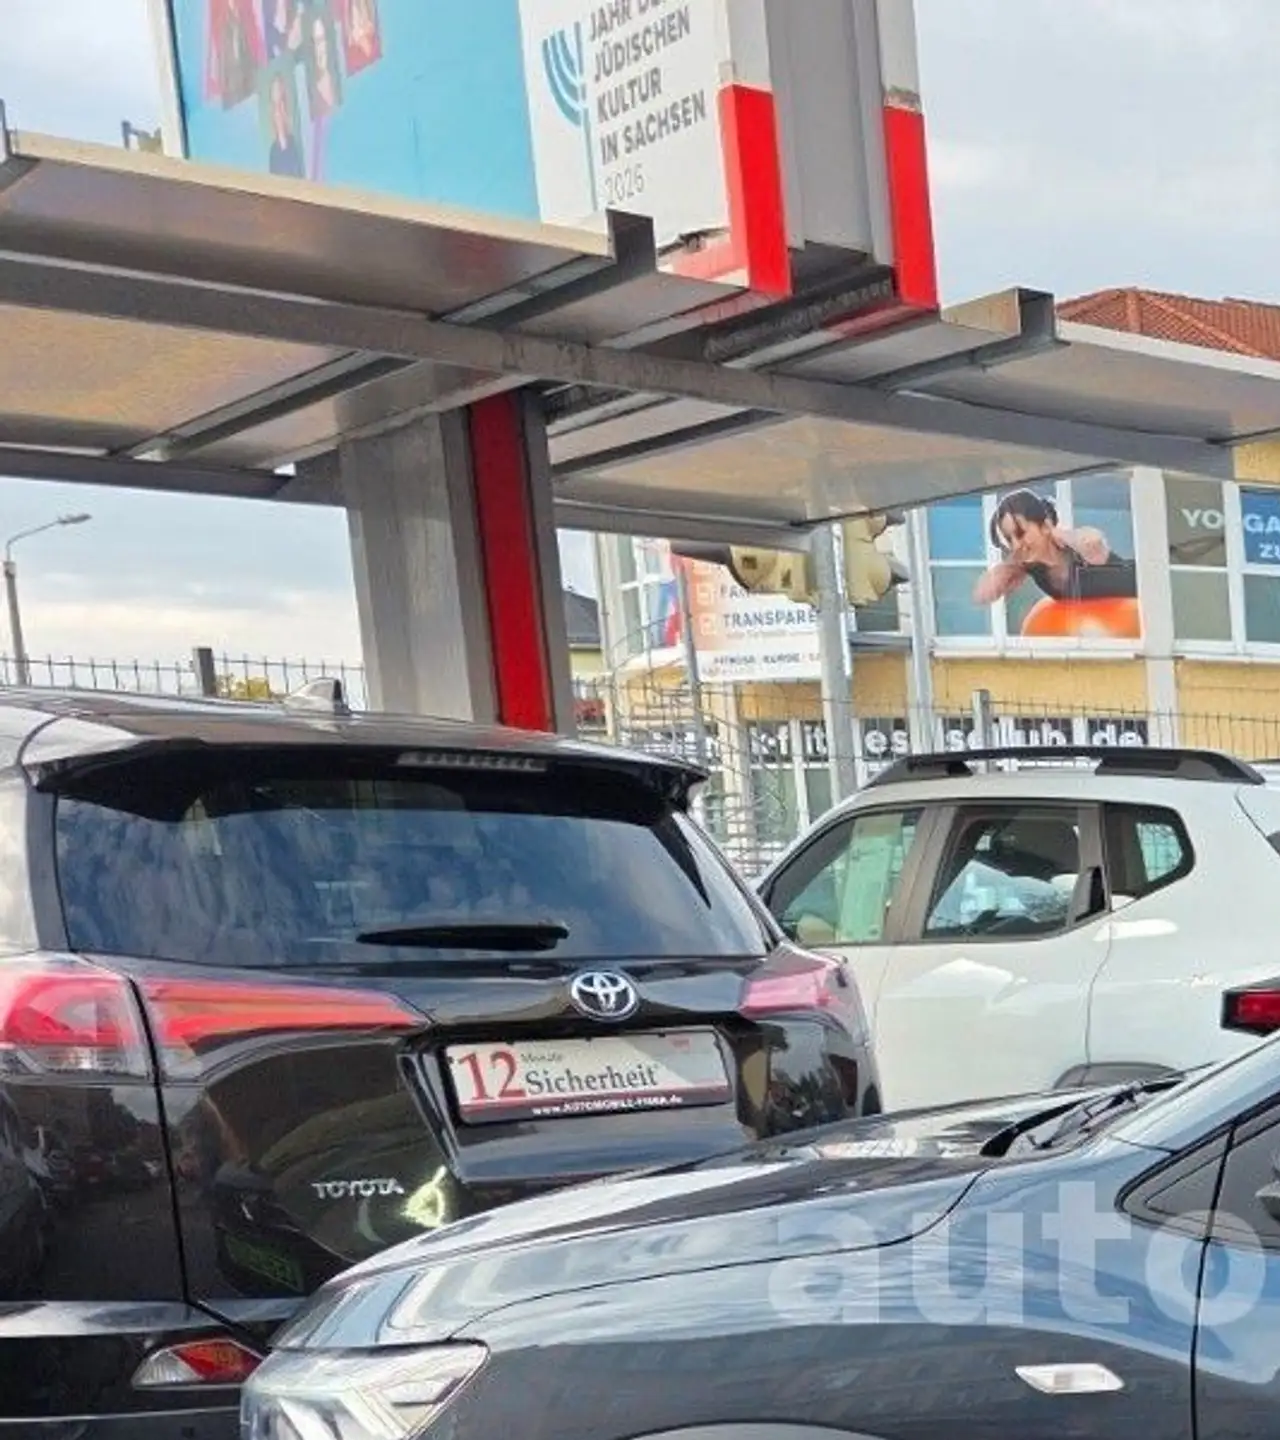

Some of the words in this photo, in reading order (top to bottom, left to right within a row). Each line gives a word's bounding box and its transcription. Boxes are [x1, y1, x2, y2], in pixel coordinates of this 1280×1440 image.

[590, 0, 632, 42] JAHR
[594, 5, 690, 83] JÜDISCHEN
[597, 66, 662, 124] KULTUR
[600, 131, 618, 165] IN
[623, 89, 706, 154] SACHSEN
[605, 163, 645, 205] 2026
[723, 607, 818, 629] TRANSPARE
[459, 1050, 526, 1101] 12
[525, 1063, 656, 1096] Sicherheit
[311, 1177, 405, 1200] TOYOTA
